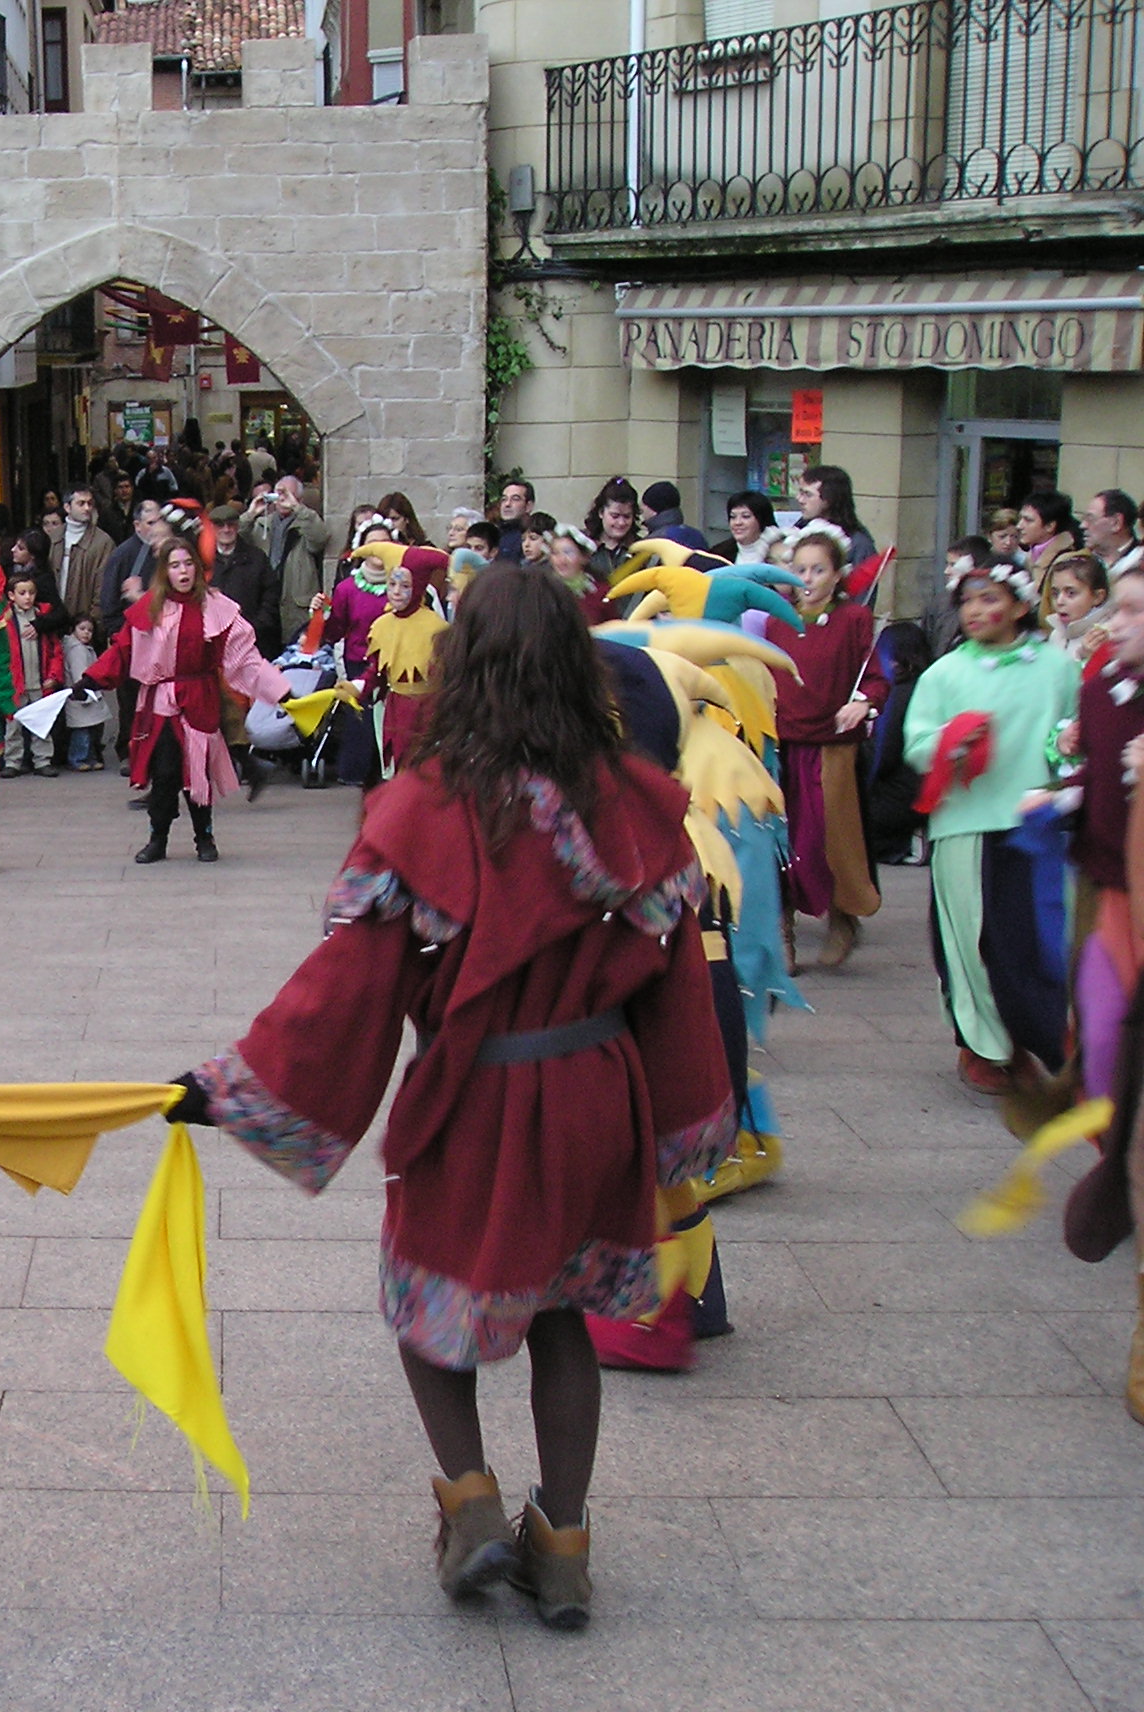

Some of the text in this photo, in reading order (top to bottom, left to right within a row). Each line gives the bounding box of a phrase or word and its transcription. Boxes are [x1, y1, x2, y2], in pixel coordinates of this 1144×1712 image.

[623, 317, 1085, 362] PANADERIA STO DOMINGO
